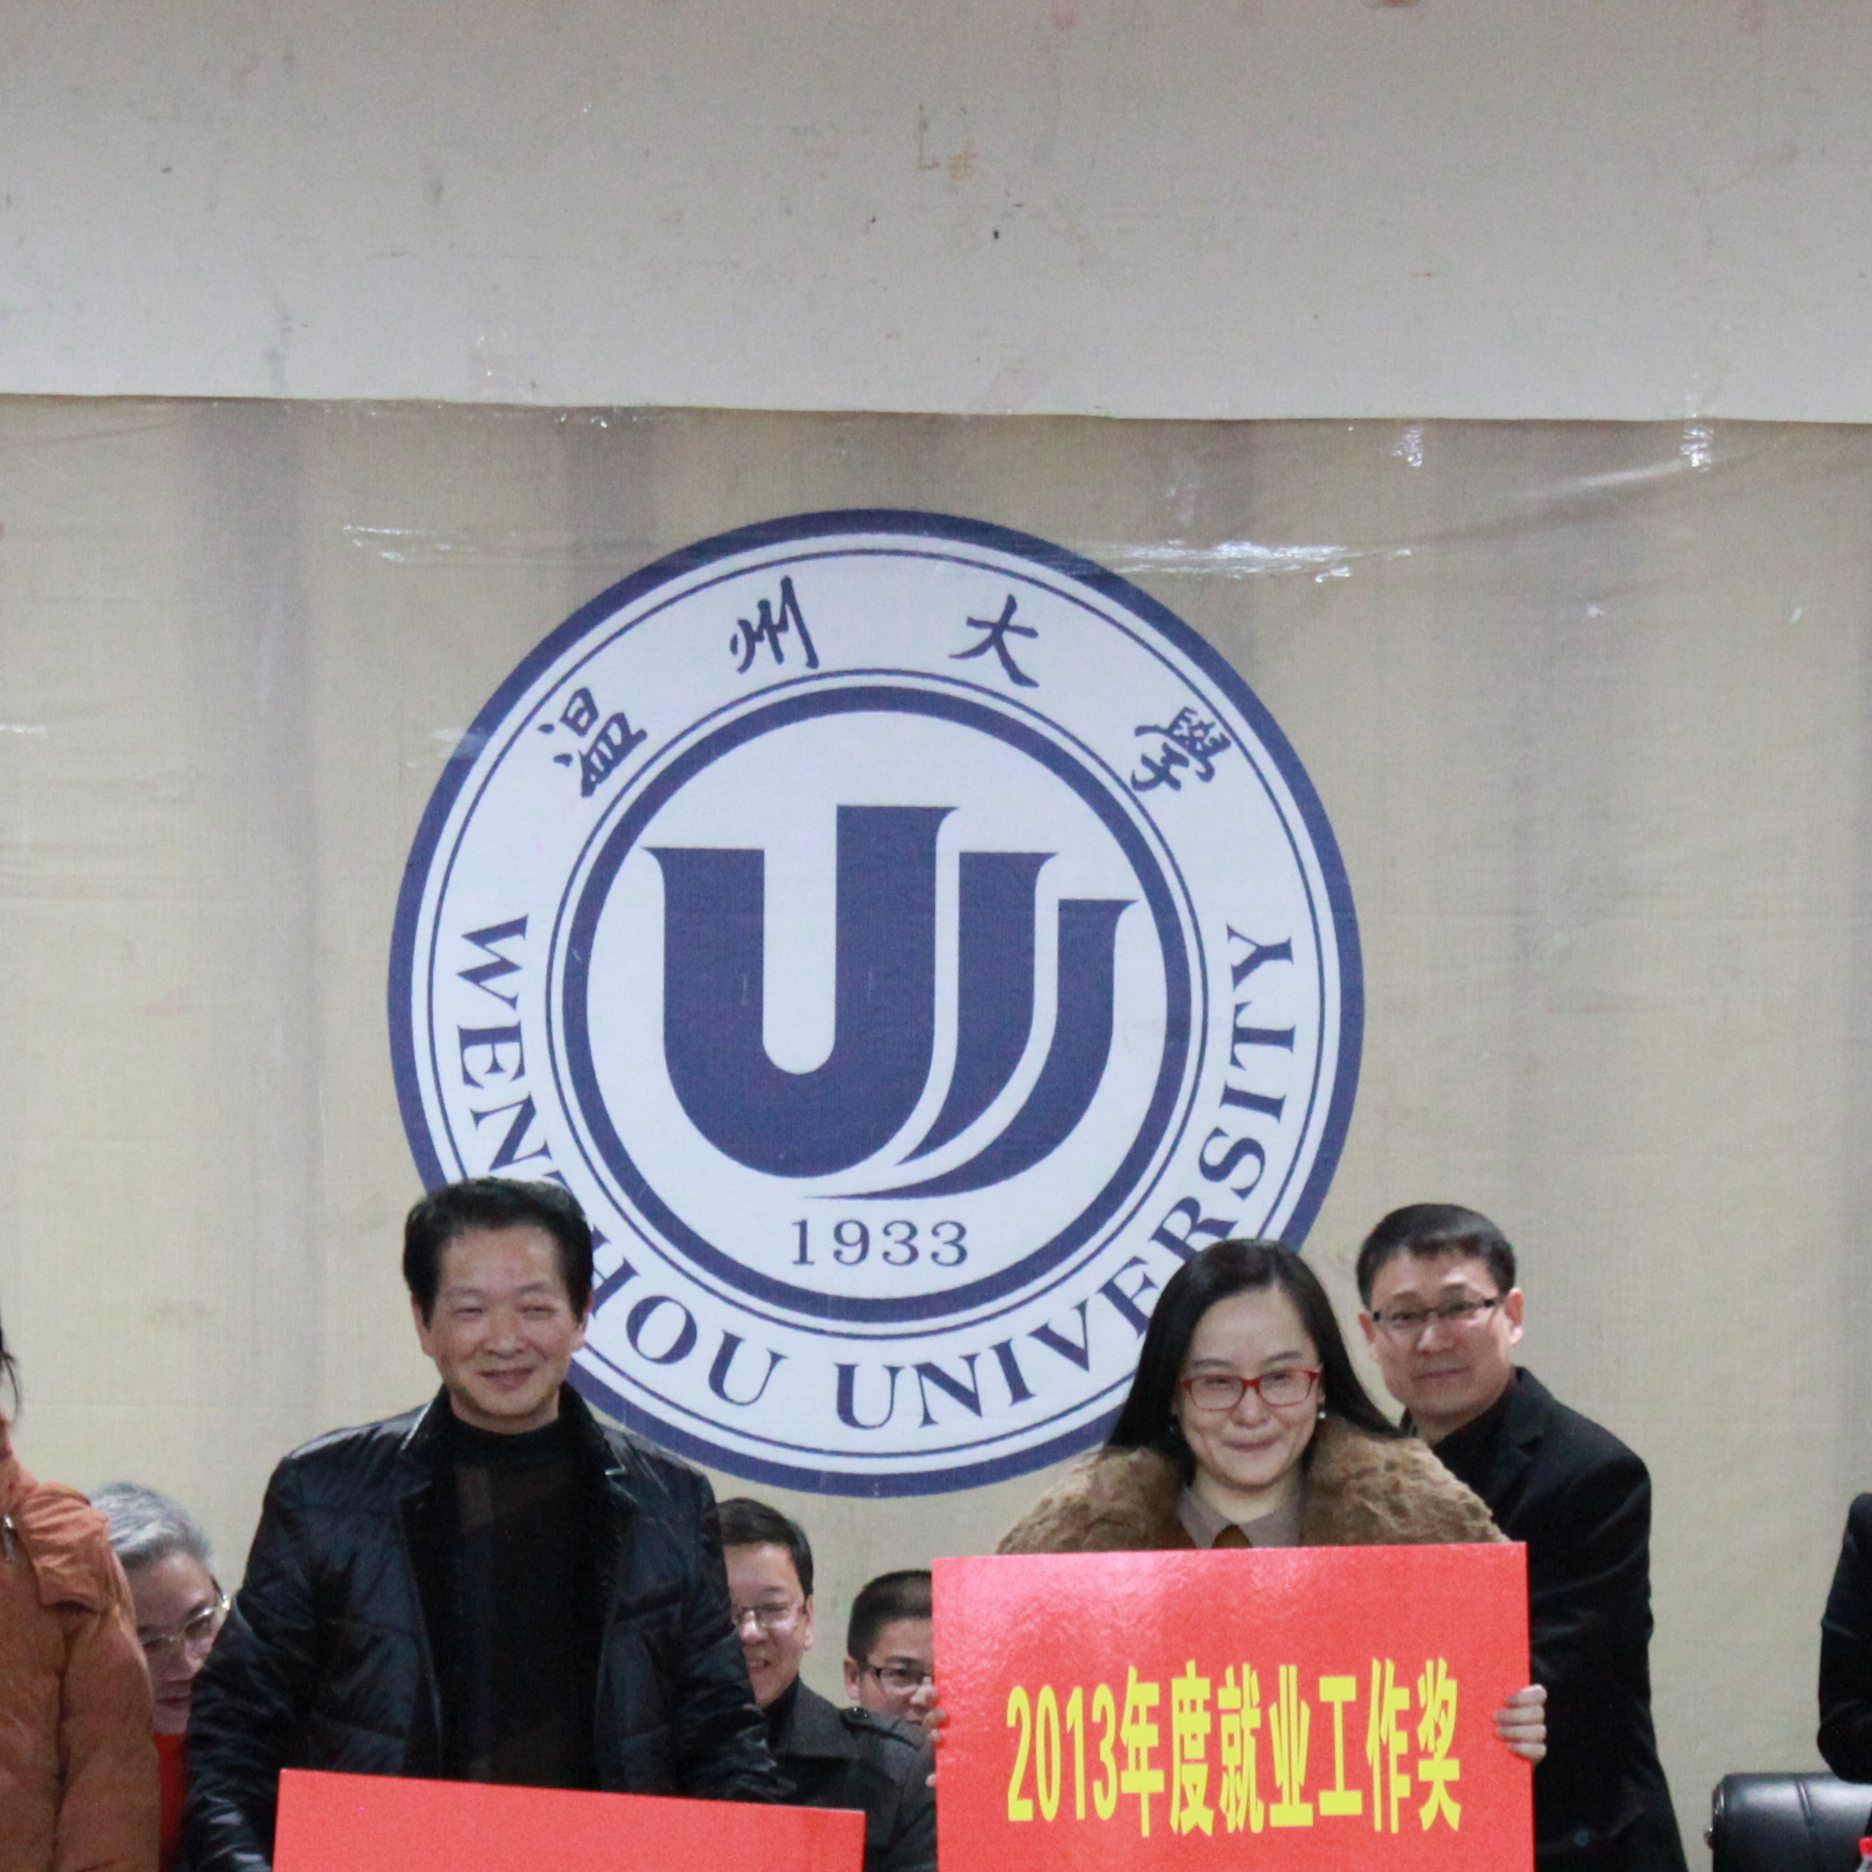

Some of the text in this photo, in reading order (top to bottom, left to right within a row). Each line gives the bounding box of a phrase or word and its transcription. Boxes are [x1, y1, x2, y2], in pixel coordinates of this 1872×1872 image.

[456, 914, 1297, 1430] WENHOU UNIVERSITY
[791, 1218, 969, 1267] 1933
[1008, 1658, 1462, 1837] 2013年度就业工作奖
